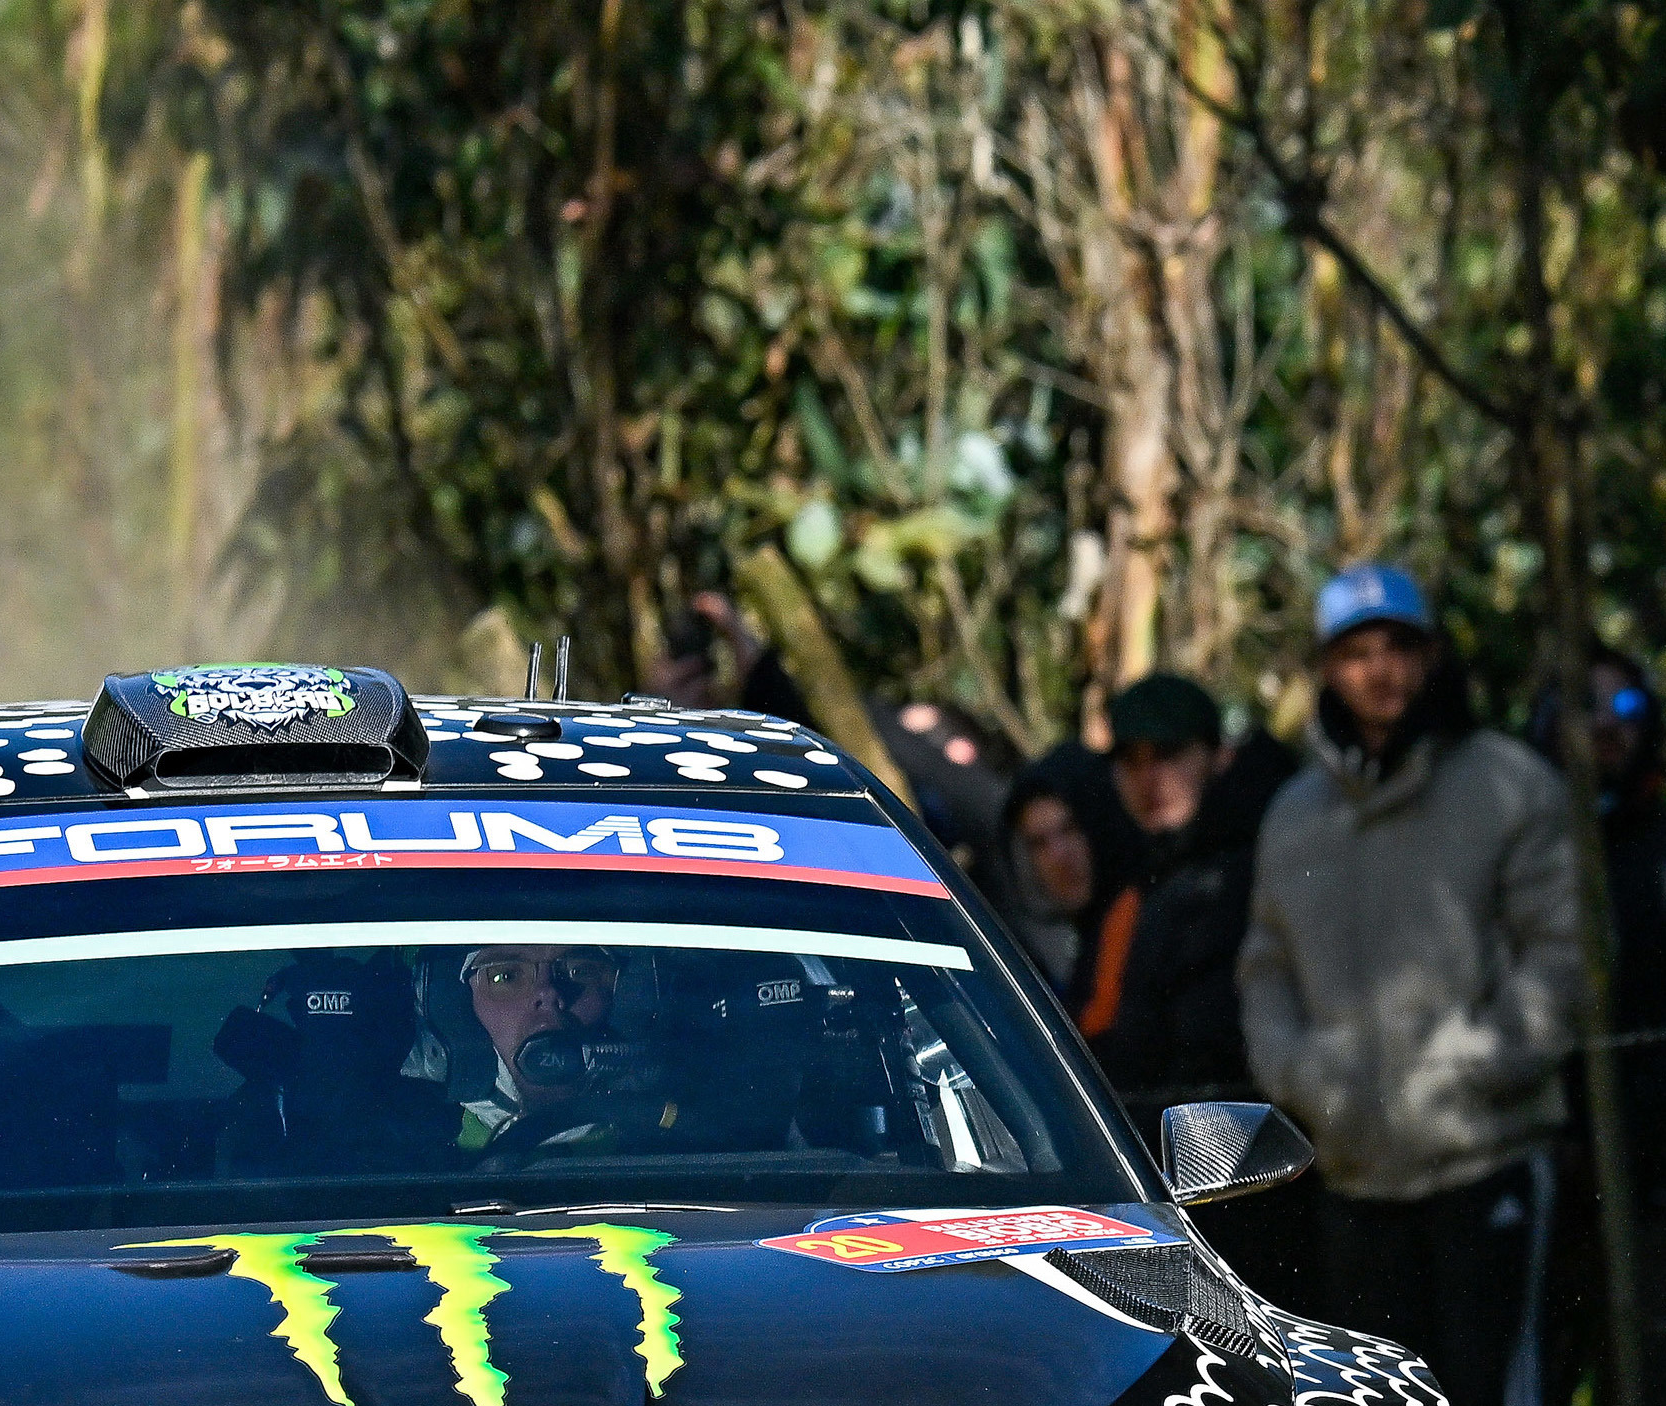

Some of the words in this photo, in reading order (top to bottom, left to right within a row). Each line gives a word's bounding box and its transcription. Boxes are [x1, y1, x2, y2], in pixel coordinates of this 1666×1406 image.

[190, 853, 393, 872] フォーラムエイト
[757, 980, 801, 1002] OMP
[306, 993, 351, 1012] OMP
[795, 1235, 904, 1259] 20
